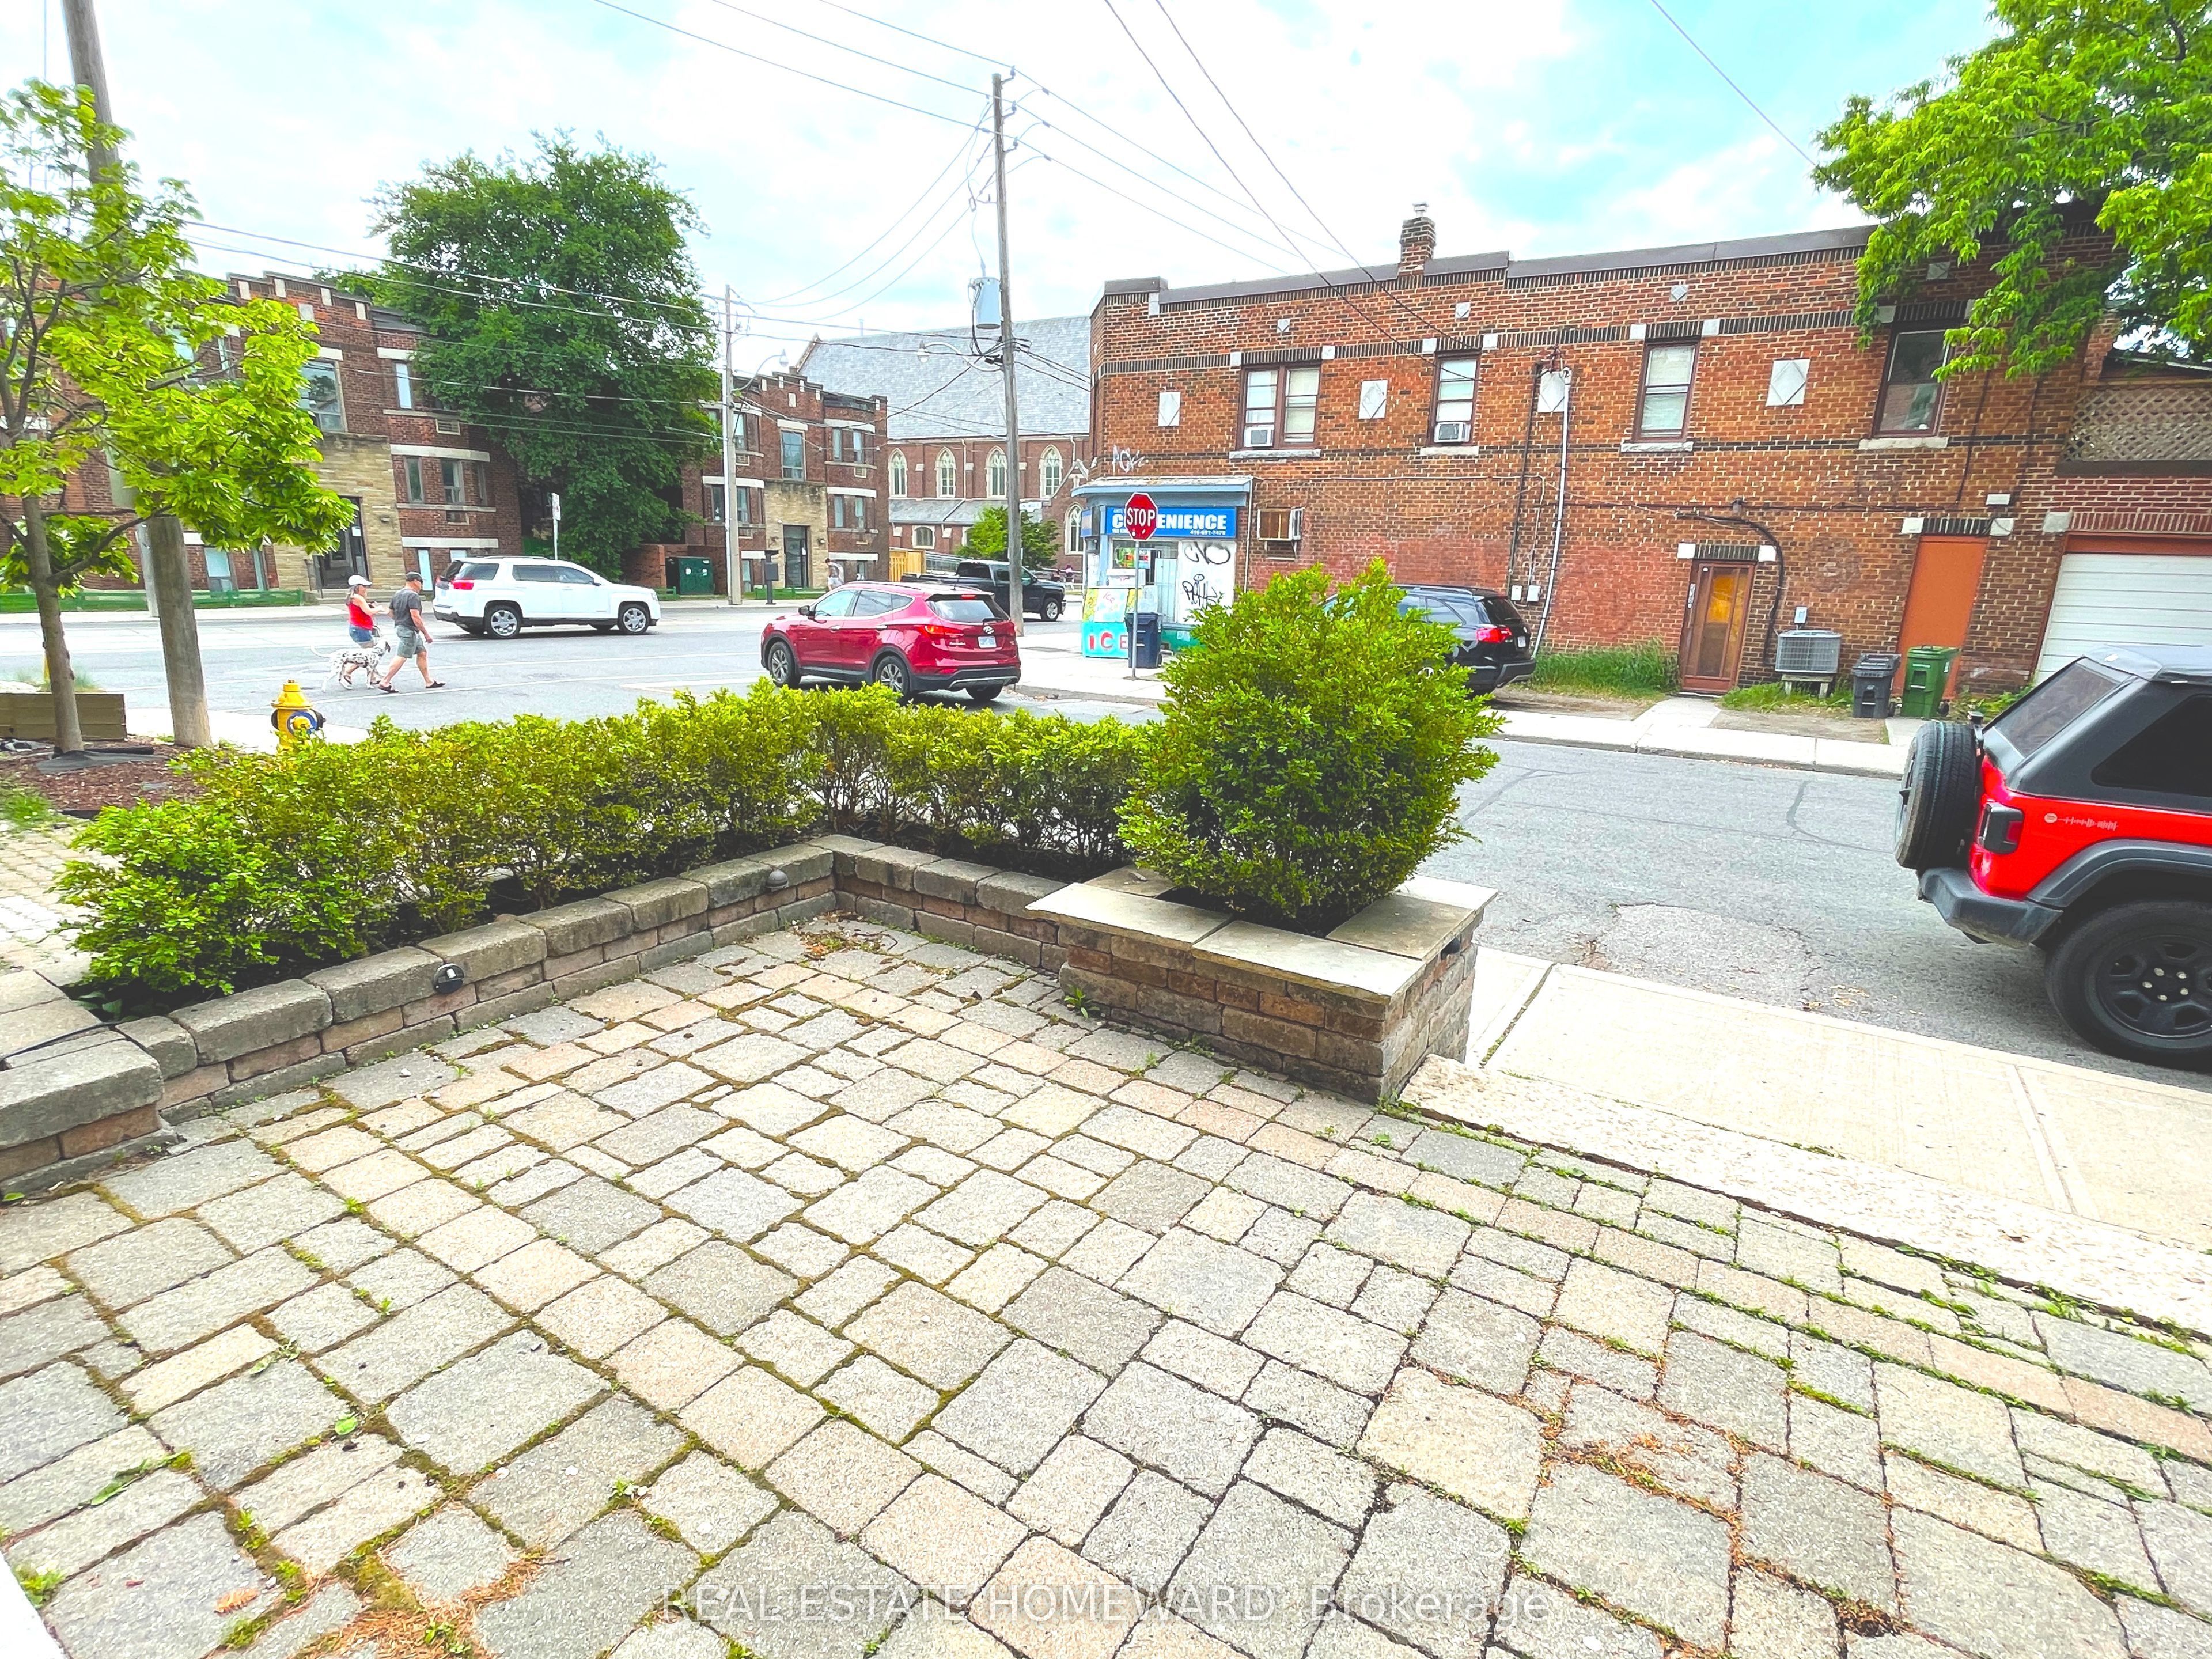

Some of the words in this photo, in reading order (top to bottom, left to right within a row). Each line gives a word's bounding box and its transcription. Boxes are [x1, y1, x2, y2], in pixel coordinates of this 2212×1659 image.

[1112, 513, 1227, 530] CENIENCE
[1127, 507, 1156, 527] STOP
[1089, 632, 1128, 650] ICE
